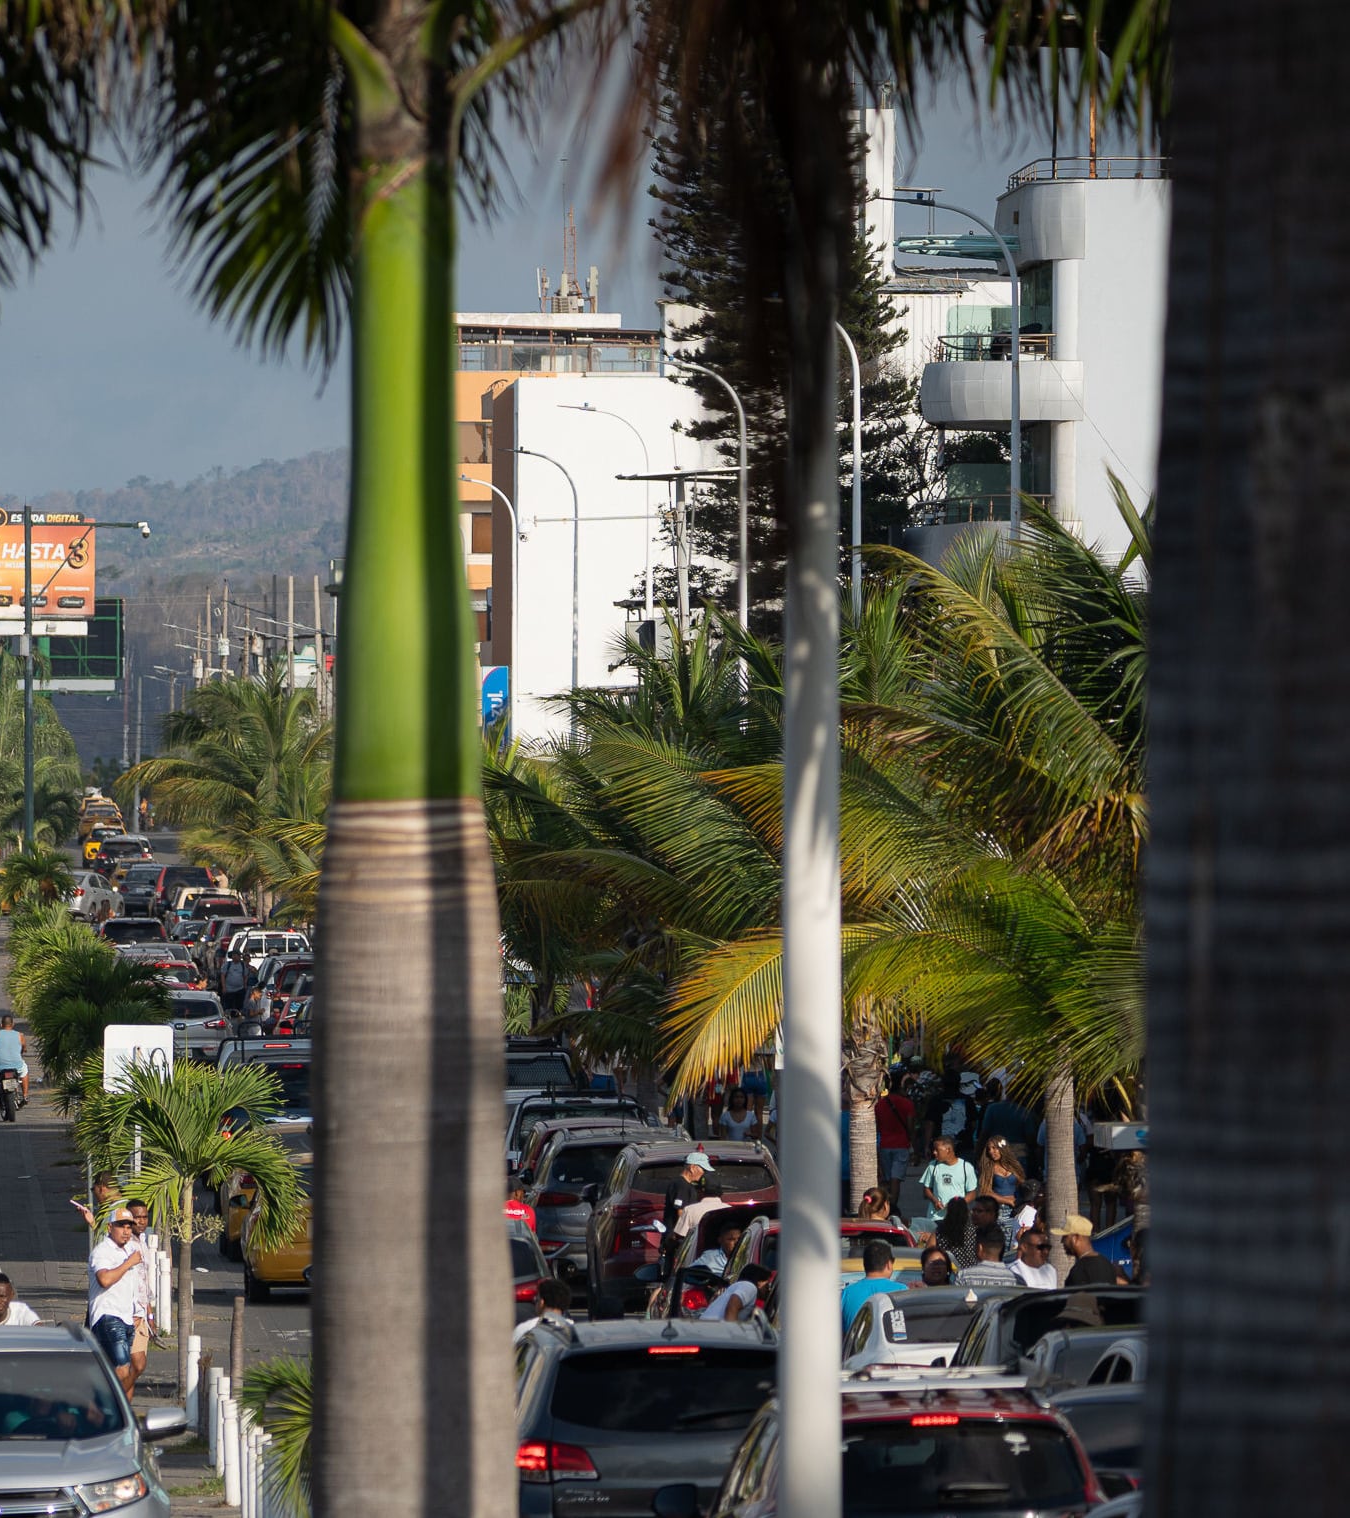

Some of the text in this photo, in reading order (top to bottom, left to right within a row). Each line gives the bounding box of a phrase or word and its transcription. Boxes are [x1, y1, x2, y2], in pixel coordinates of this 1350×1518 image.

[46, 513, 80, 523] DIGITAL
[2, 542, 66, 560] HASTA
[68, 538, 89, 569] 3
